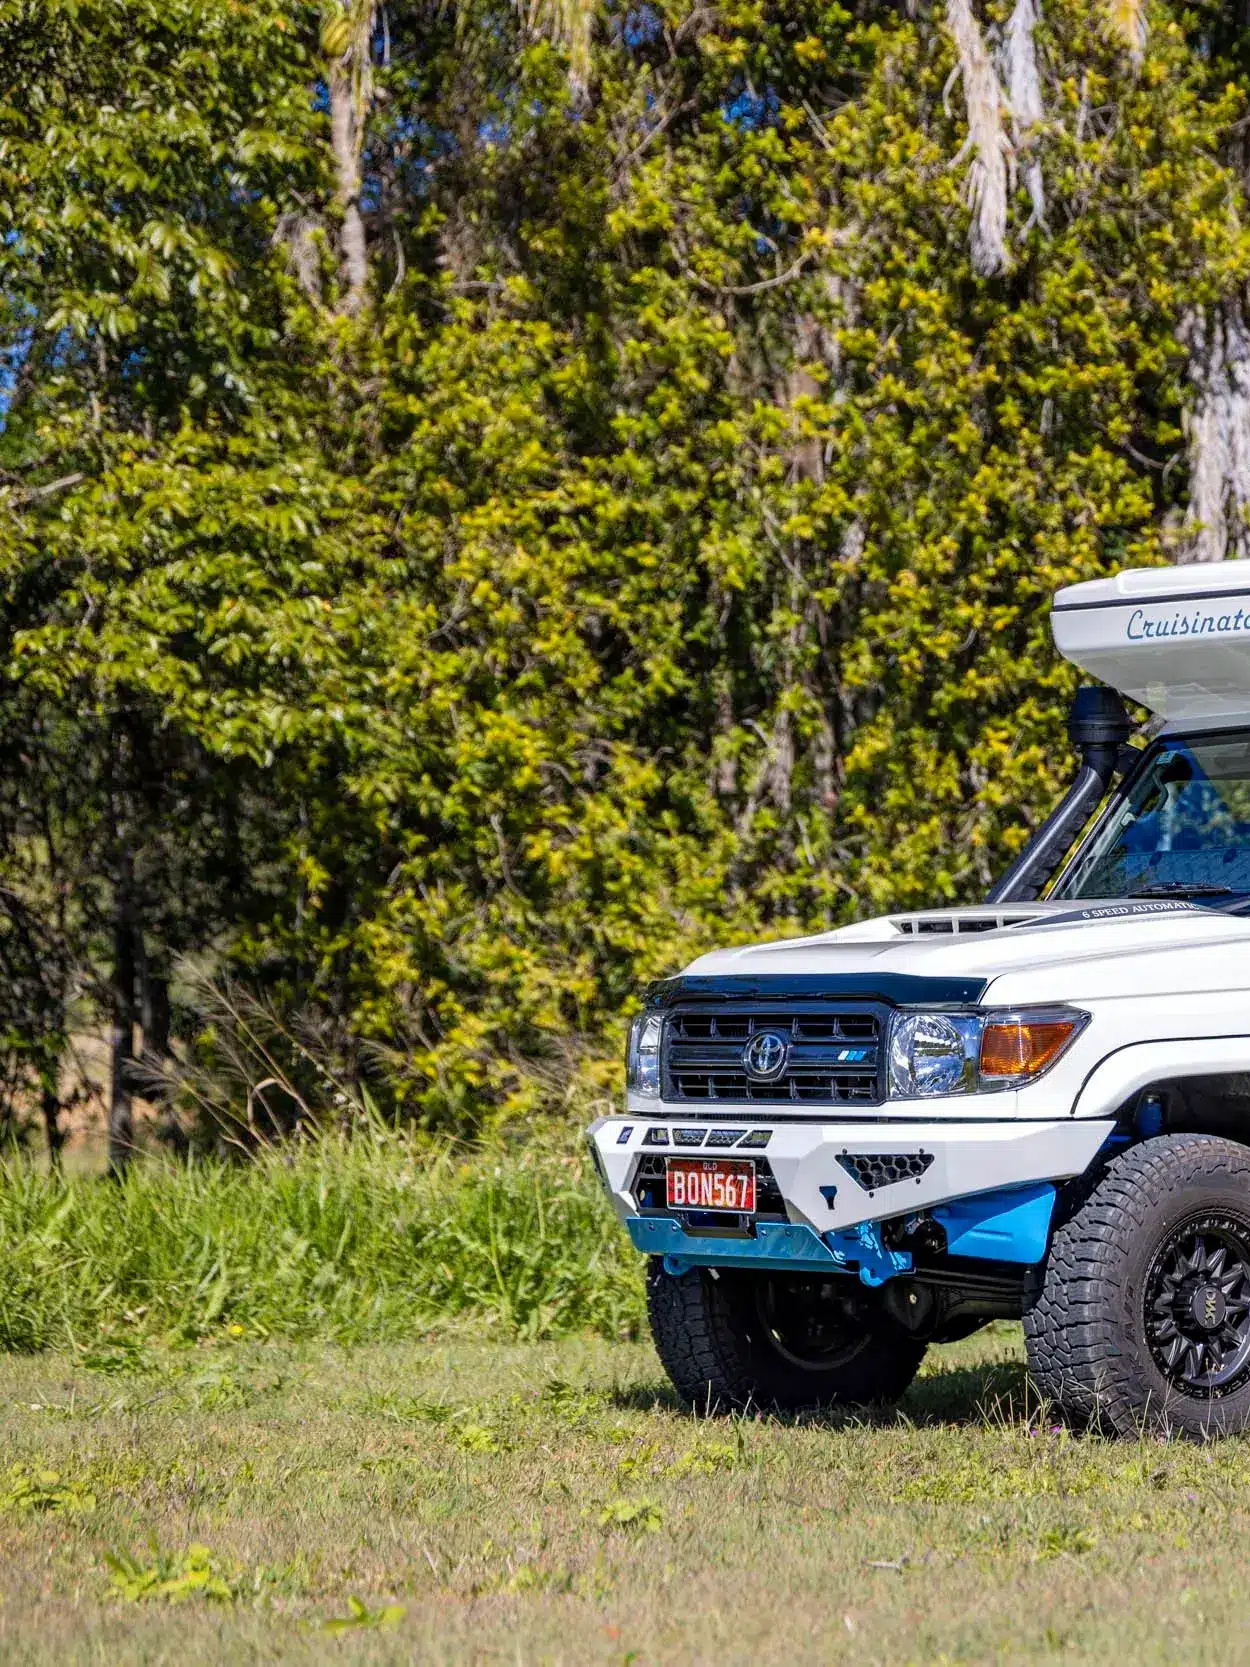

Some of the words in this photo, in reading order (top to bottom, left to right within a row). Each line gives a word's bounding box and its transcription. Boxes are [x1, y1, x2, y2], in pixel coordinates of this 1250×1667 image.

[1092, 907, 1128, 917] SPEED
[1132, 902, 1199, 913] AUTOMATIC
[702, 1162, 718, 1171] QLD
[674, 1171, 748, 1208] BON567
